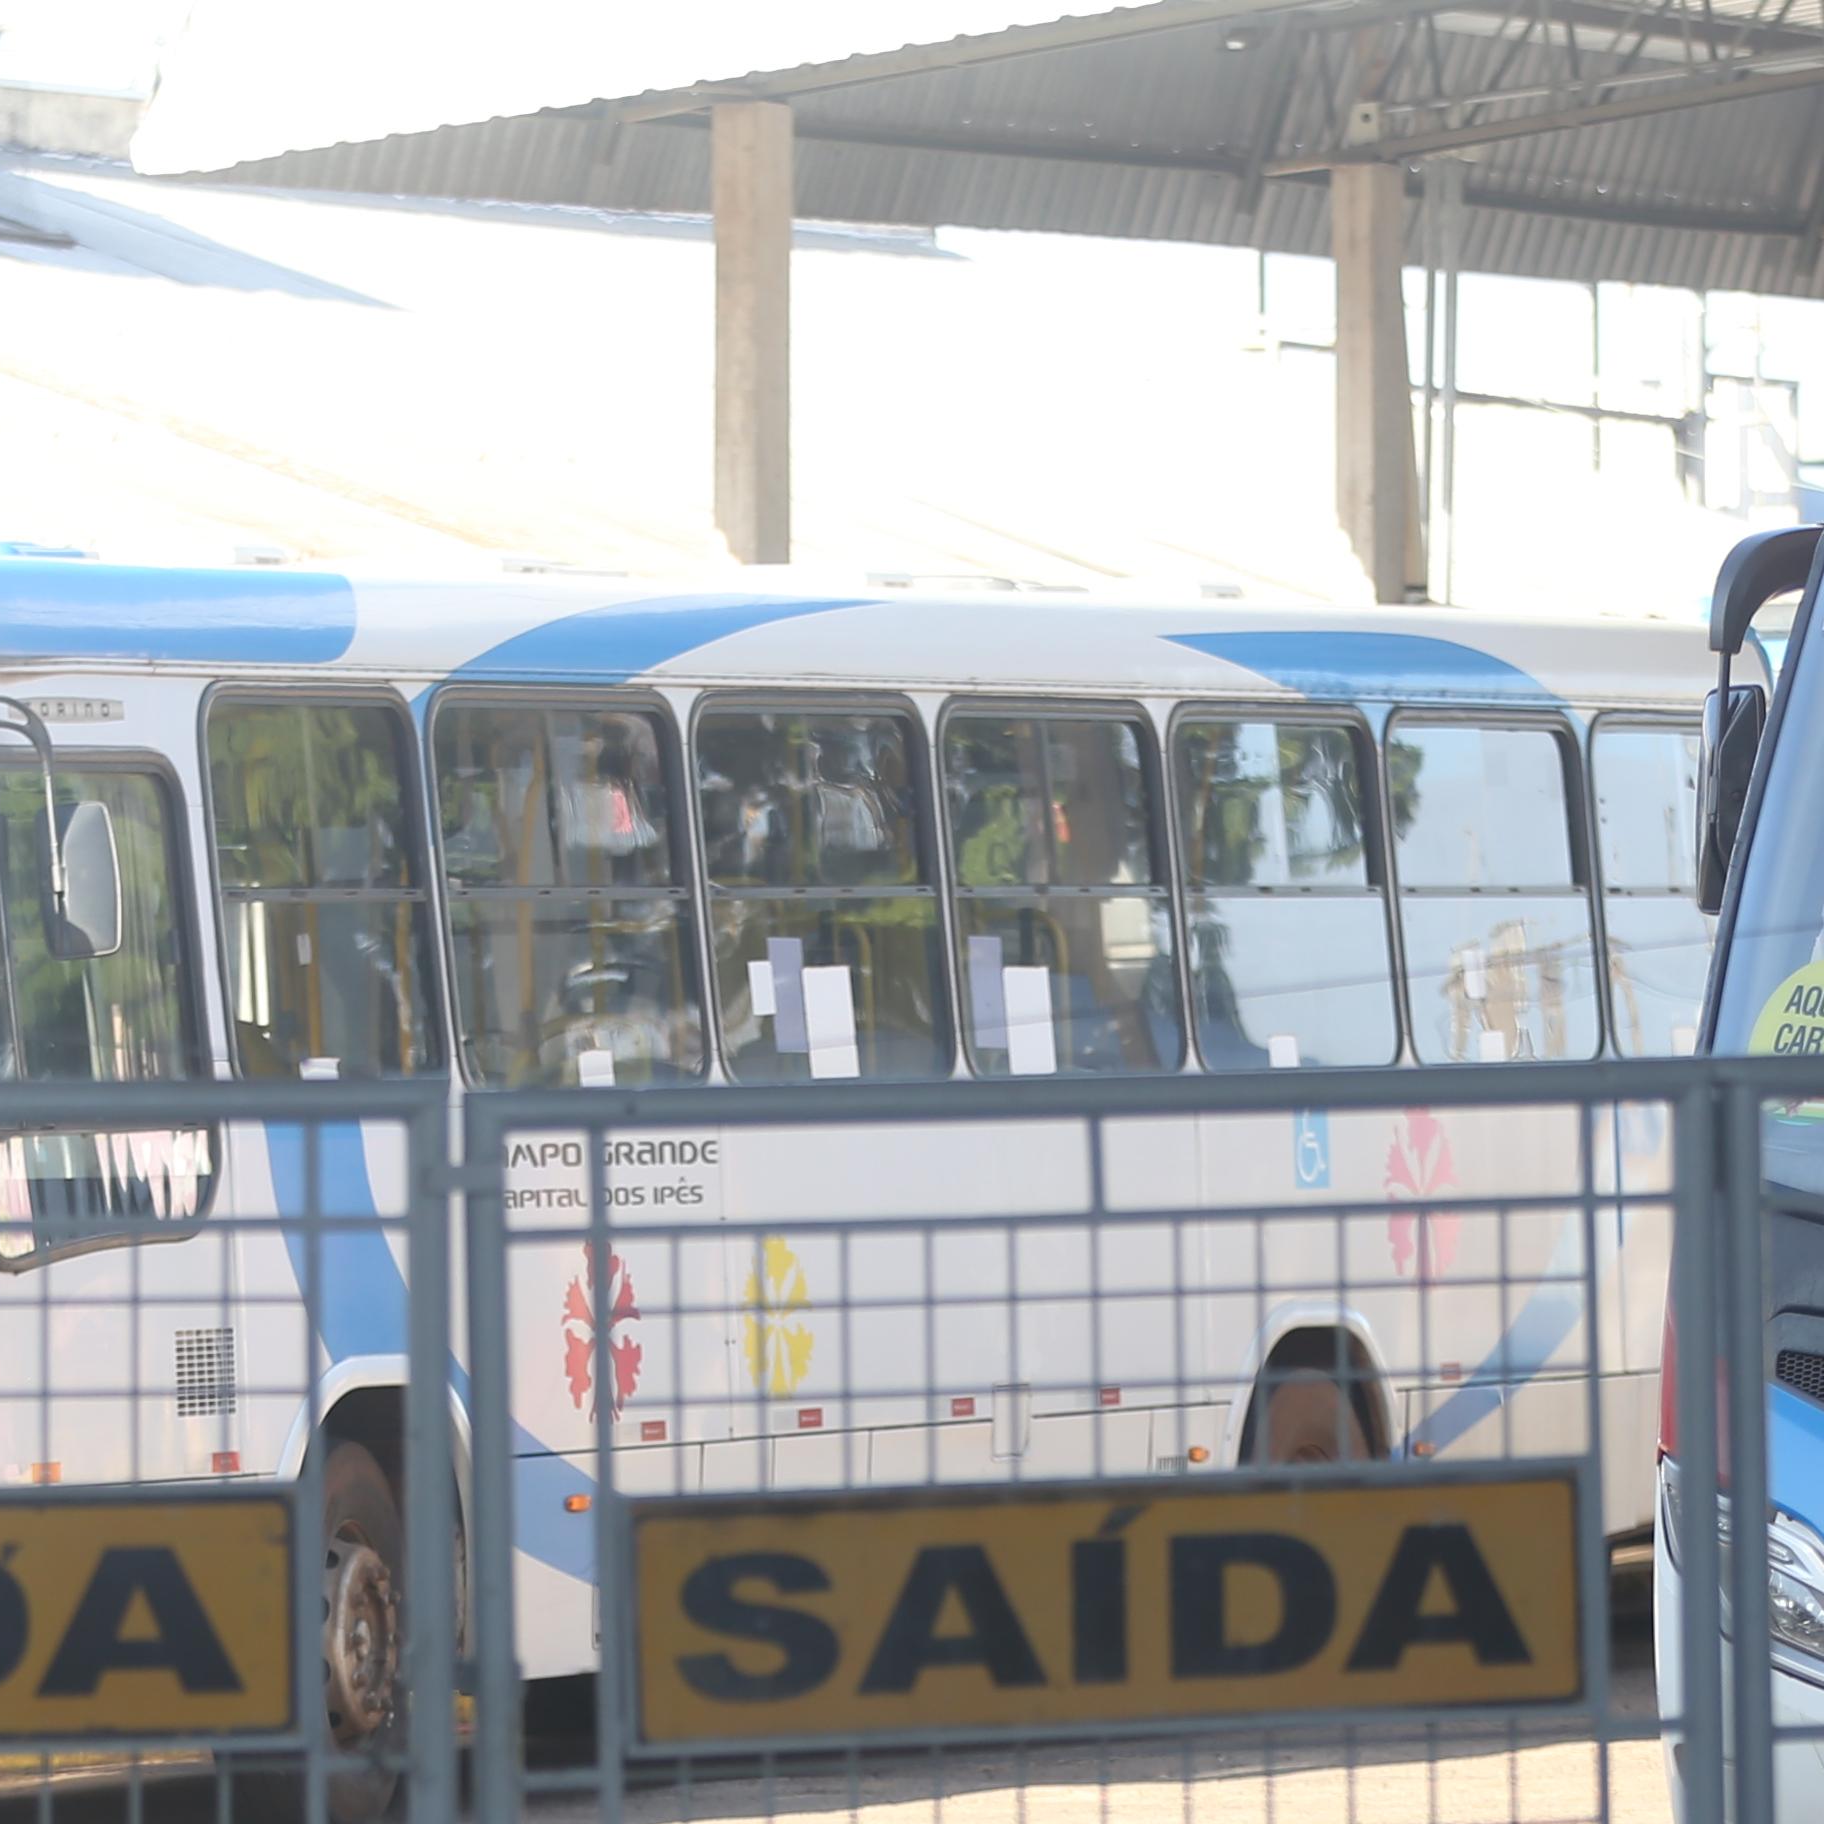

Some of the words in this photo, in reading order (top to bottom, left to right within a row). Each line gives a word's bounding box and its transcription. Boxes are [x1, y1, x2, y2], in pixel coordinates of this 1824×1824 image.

[26, 701, 110, 718] ORINO
[504, 1143, 583, 1169] MPO
[504, 1188, 588, 1209] APITAL
[653, 1176, 704, 1206] IPÊS
[674, 1504, 1533, 1704] SAÍDA
